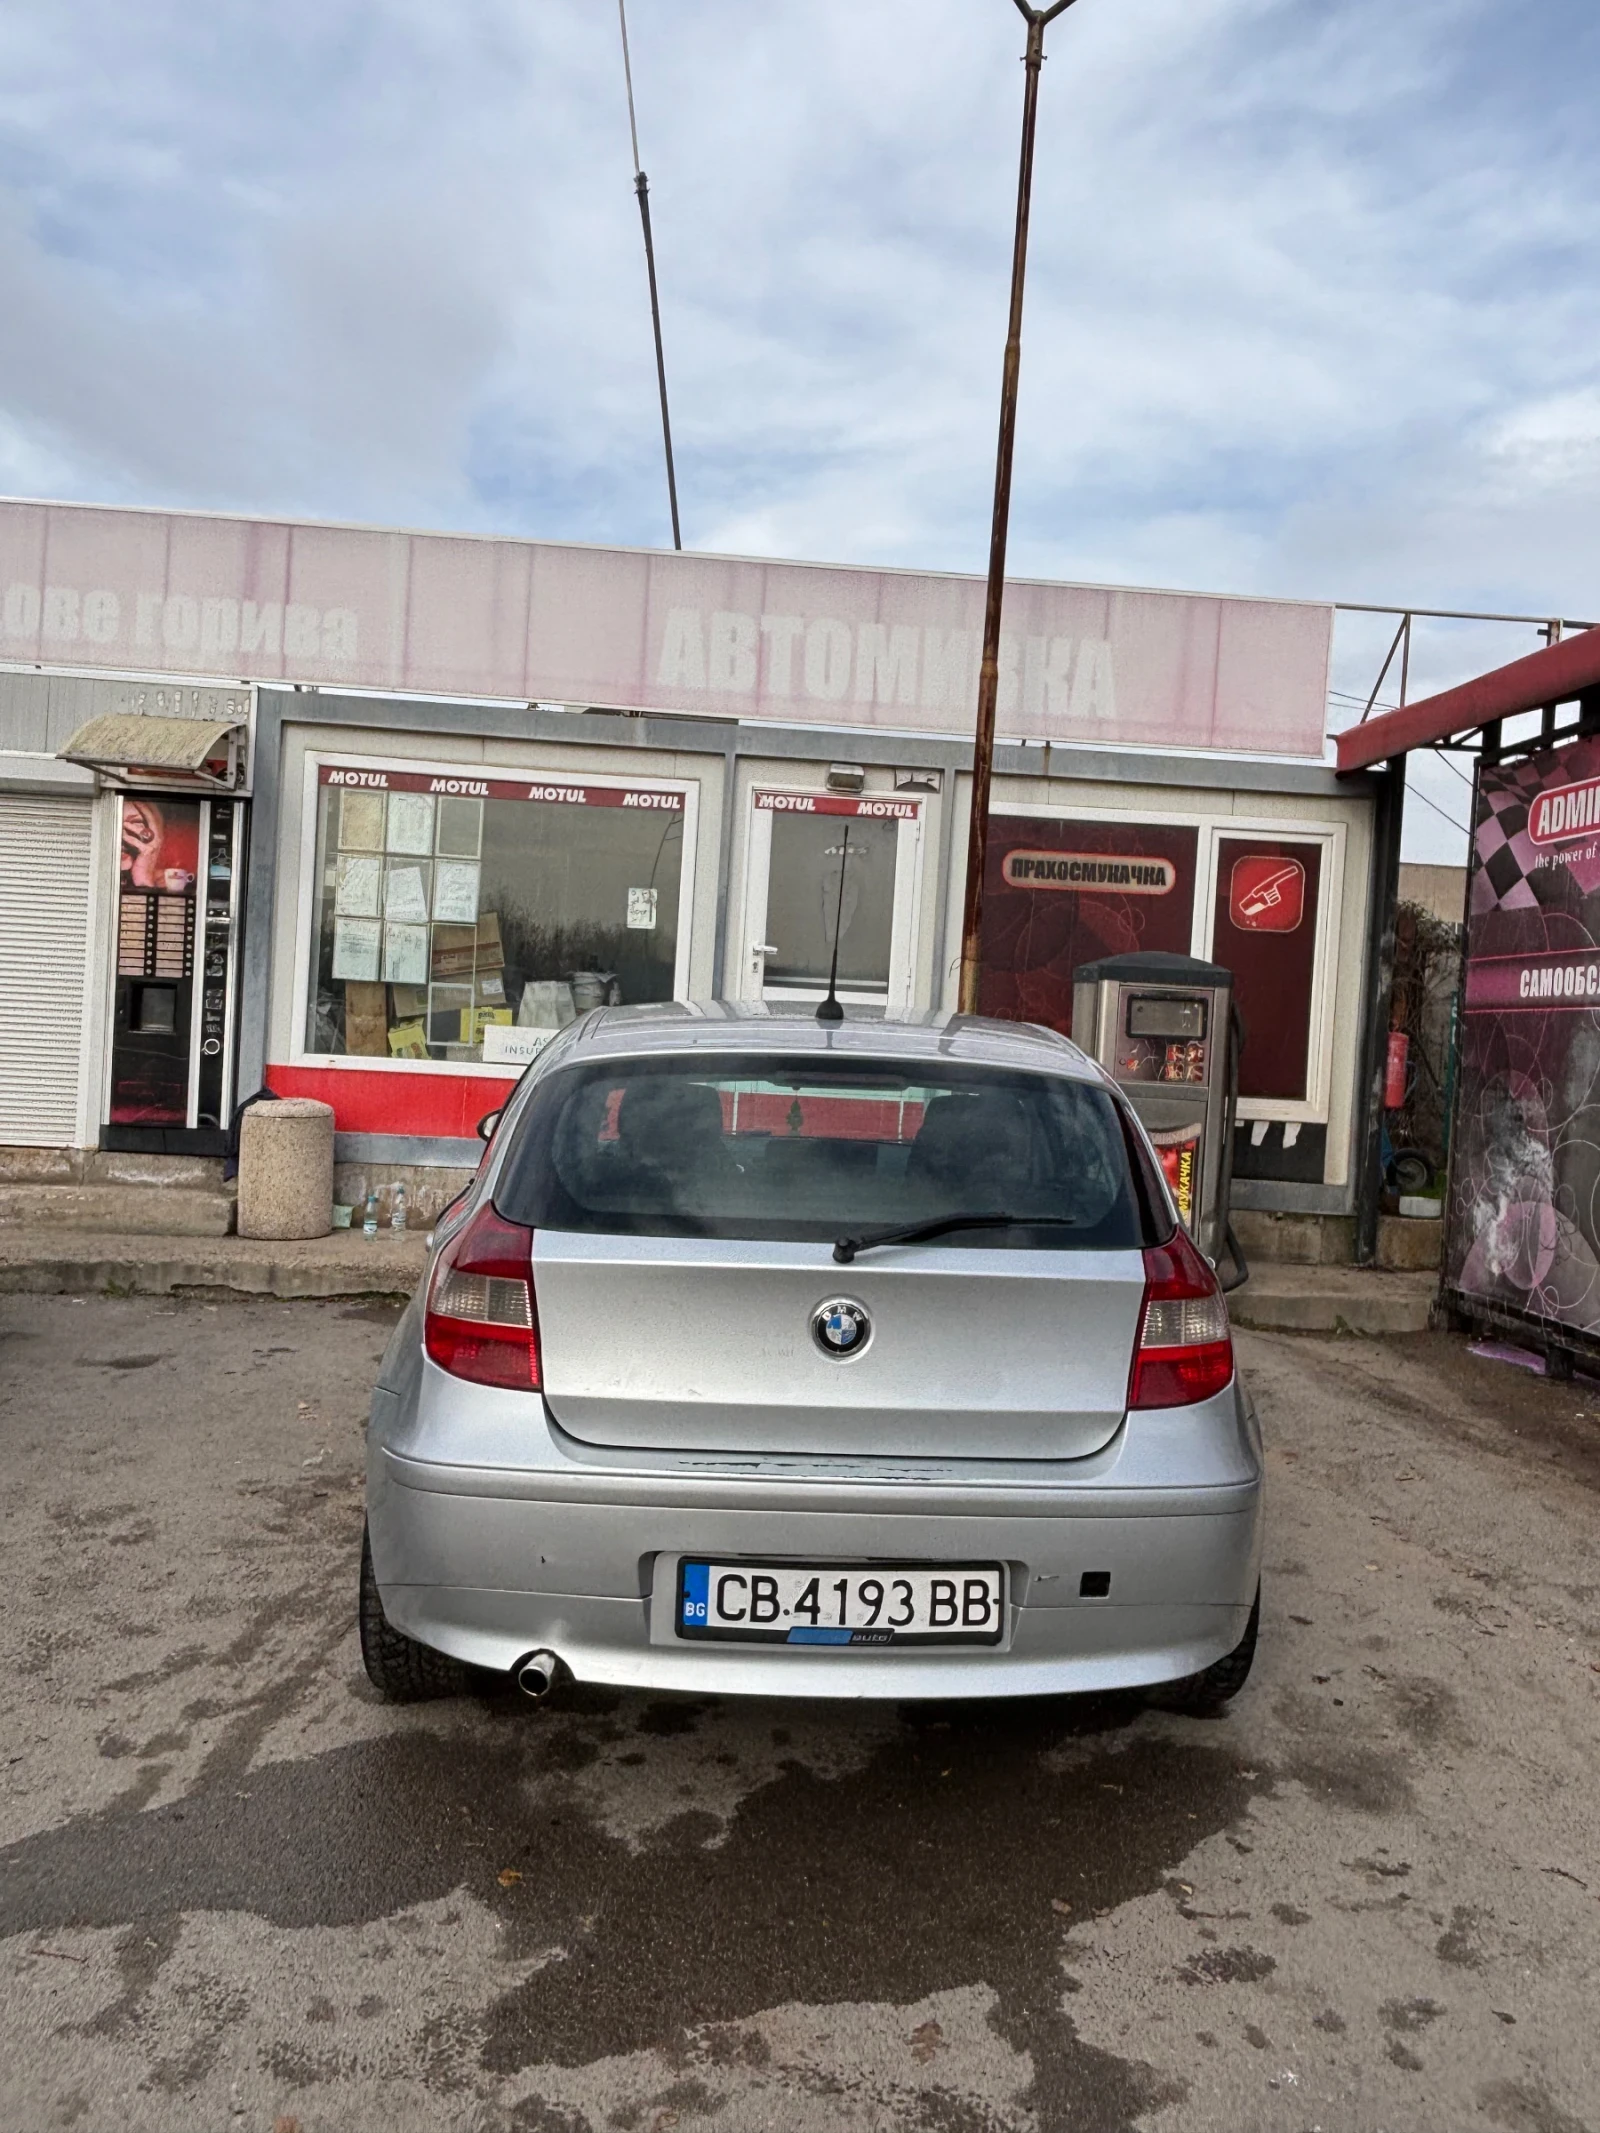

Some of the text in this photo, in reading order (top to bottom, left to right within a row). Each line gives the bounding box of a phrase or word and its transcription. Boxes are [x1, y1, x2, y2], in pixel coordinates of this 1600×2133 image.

[656, 606, 1116, 719] АВТОМИВКА
[328, 770, 681, 810] MOTUL MOTUL MOTUL MOTUL
[758, 794, 914, 818] MOTUL MOTUL
[1535, 841, 1598, 871] the power of
[1011, 858, 1167, 887] ПРАХОСМУКАЧКА
[1520, 965, 1600, 998] САМООБС
[685, 1602, 706, 1617] BG
[716, 1573, 992, 1627] CB 4193 BB
